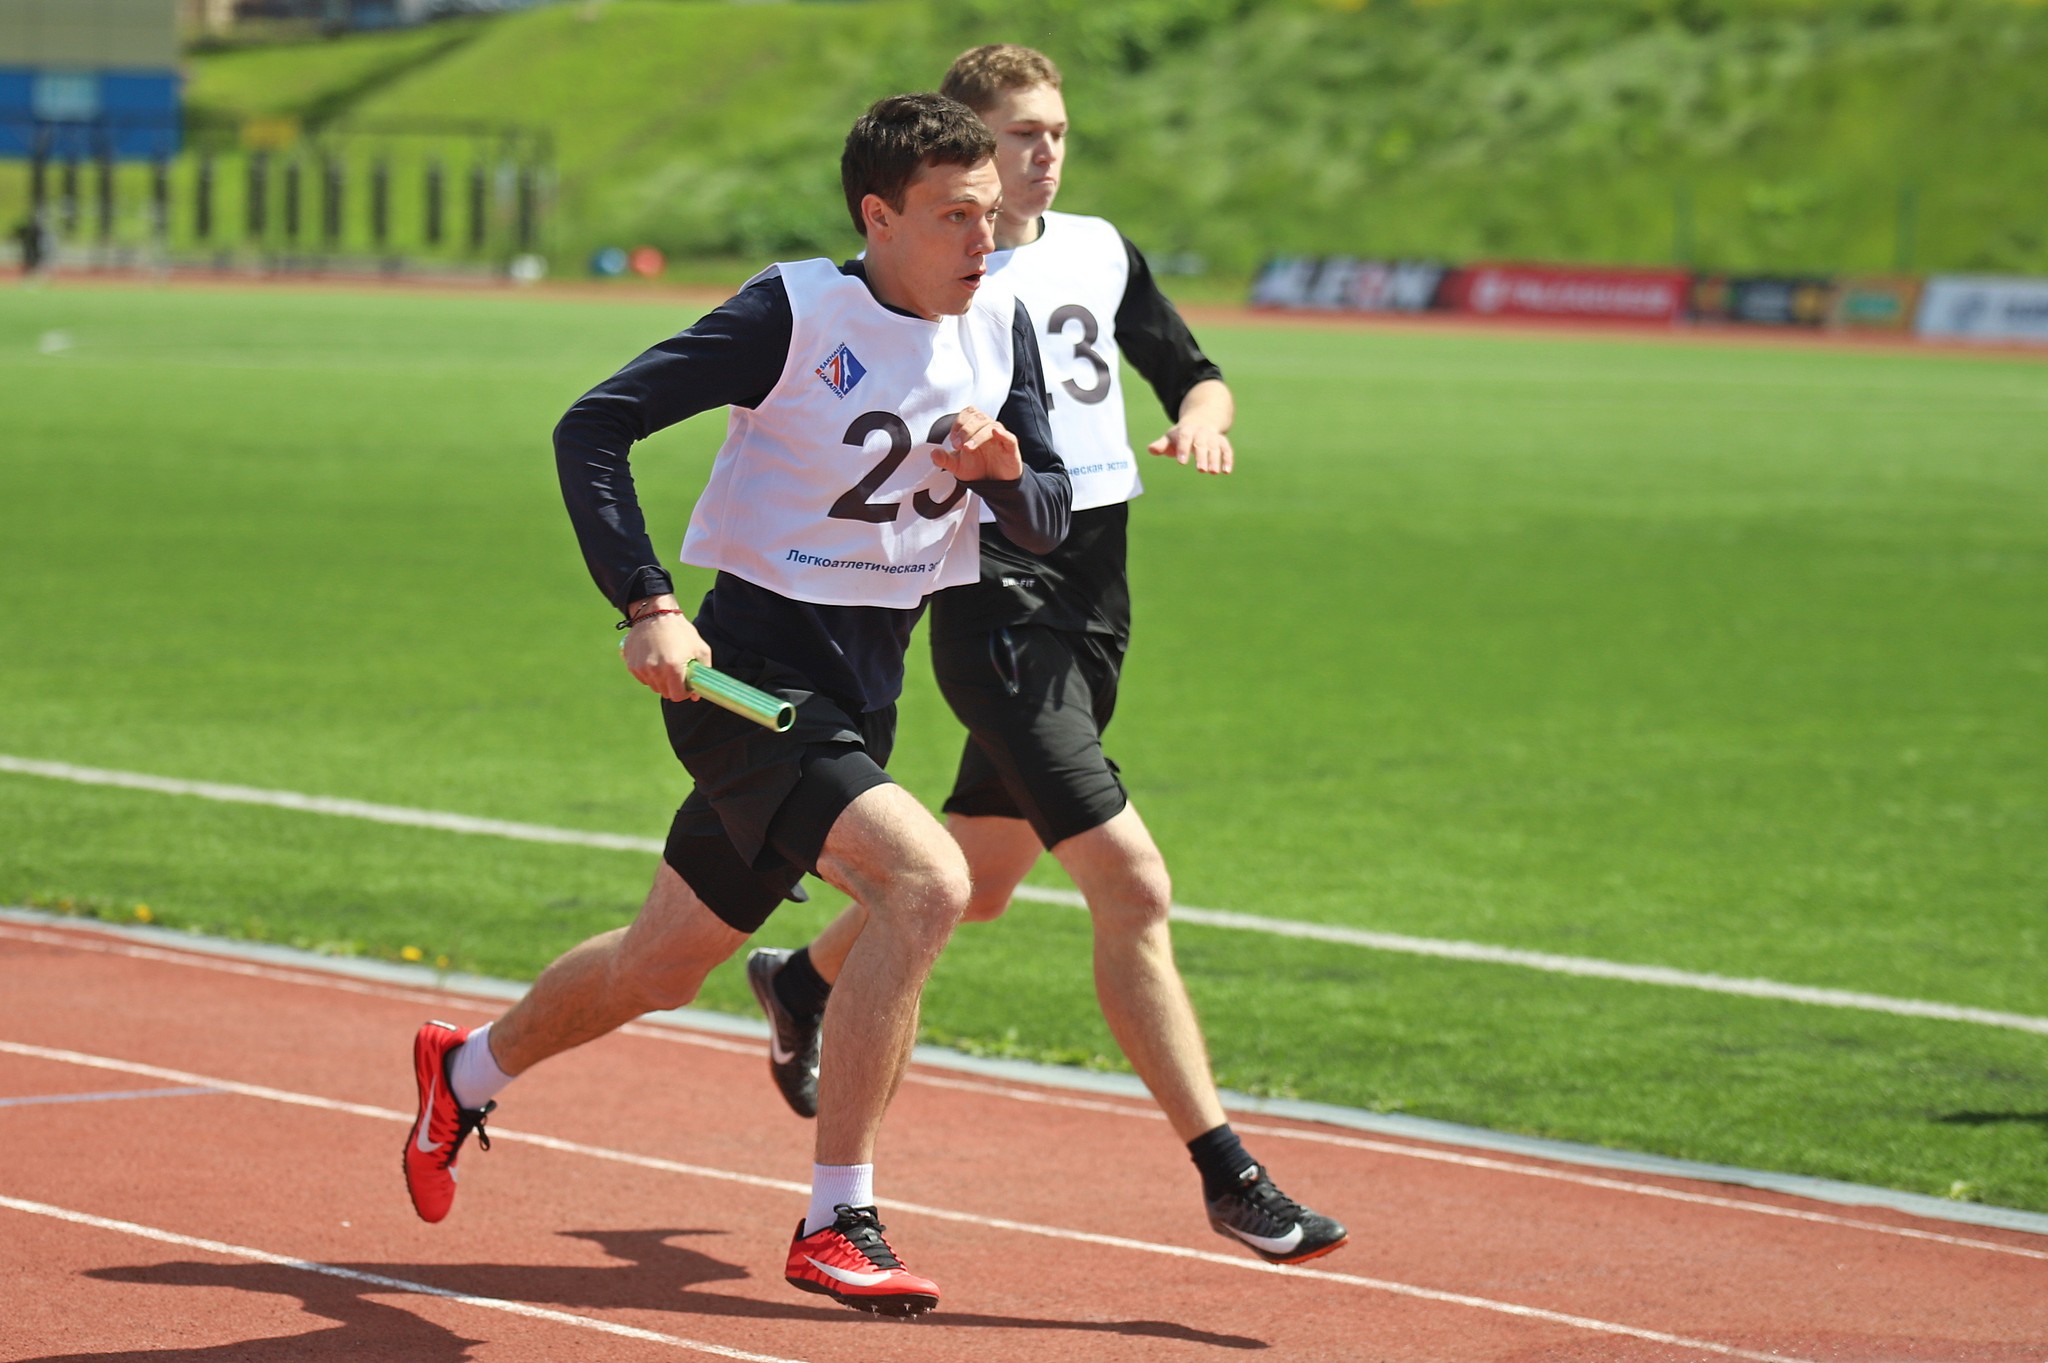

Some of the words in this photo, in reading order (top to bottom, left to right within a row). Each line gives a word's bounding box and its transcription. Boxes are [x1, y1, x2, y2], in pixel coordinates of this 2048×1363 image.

[820, 341, 845, 370] SAKHALIN
[1046, 304, 1111, 411] 3
[820, 372, 844, 400] САХАЛИН
[786, 549, 925, 574] Легкоатлетическая
